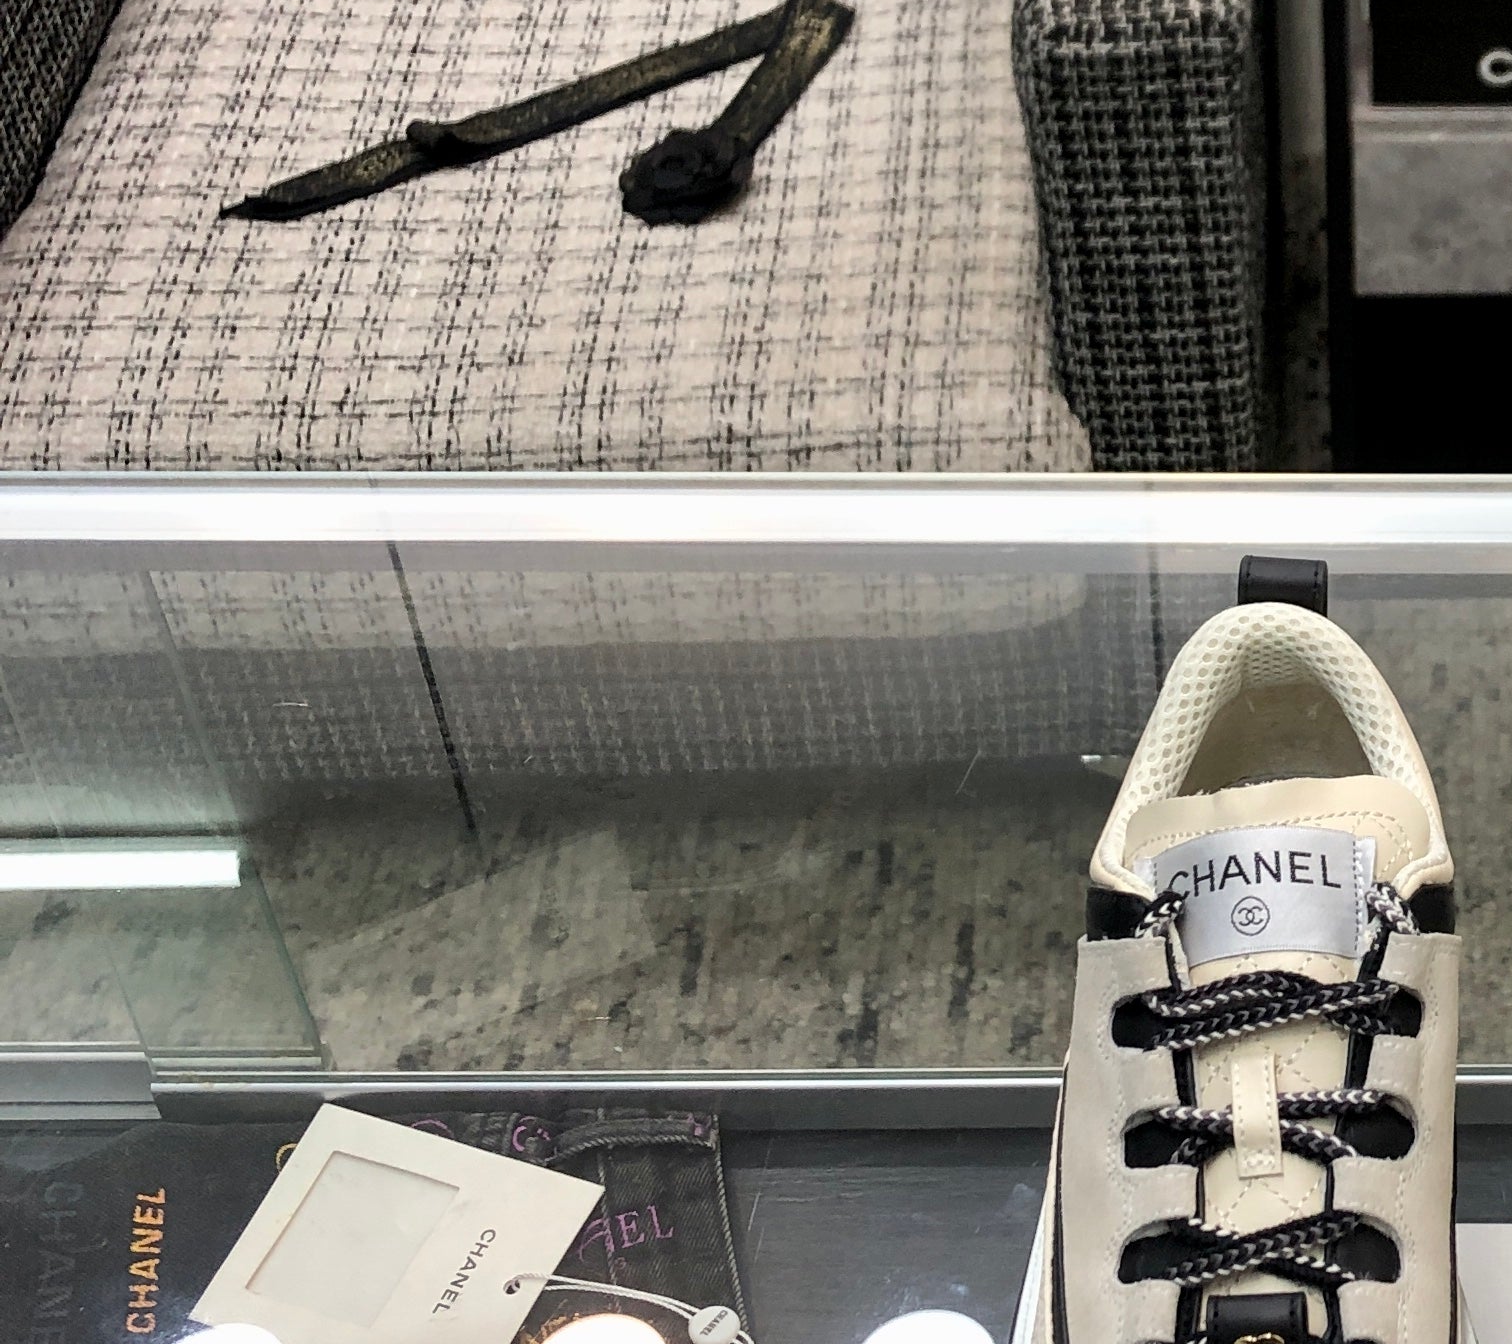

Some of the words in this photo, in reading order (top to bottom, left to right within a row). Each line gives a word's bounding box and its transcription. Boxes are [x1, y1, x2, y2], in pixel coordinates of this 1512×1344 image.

[1166, 849, 1342, 901] CHANEL
[126, 1187, 166, 1334] CHANEL
[431, 1228, 497, 1315] CHANEL
[699, 1309, 728, 1336] CHANEL
